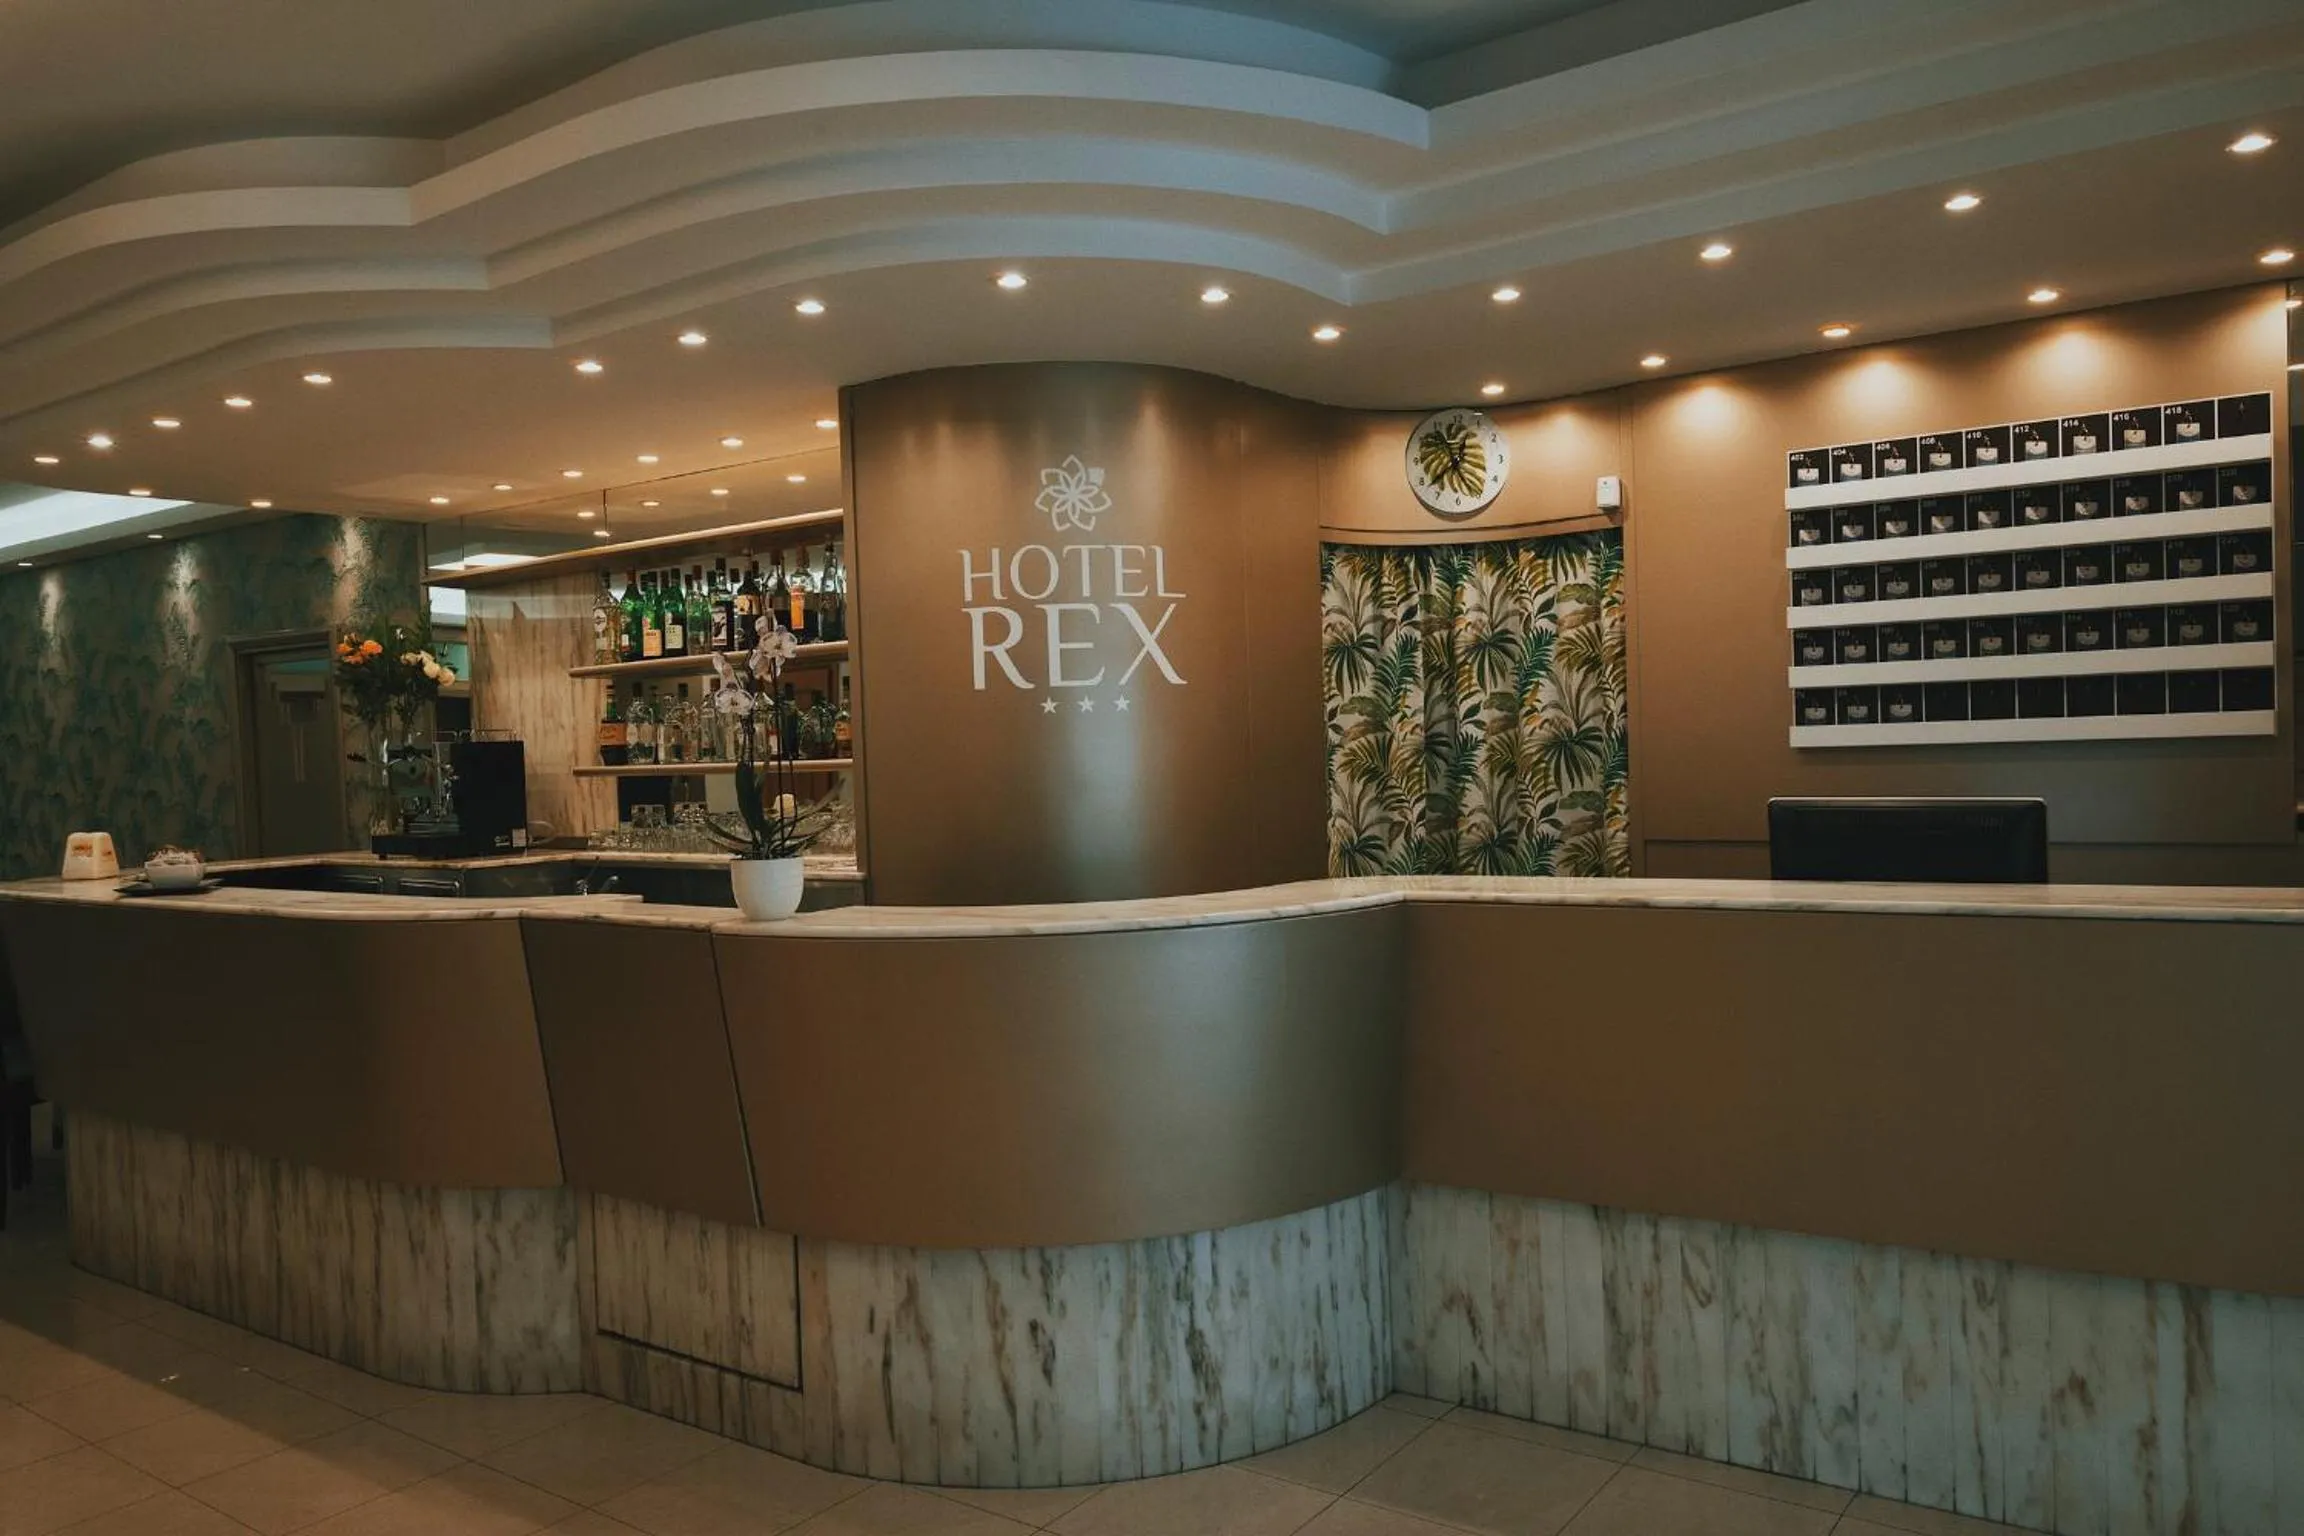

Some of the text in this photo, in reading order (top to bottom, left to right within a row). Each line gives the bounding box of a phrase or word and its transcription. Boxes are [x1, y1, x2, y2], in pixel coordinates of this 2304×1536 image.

[2165, 406, 2182, 415] 418
[2113, 413, 2130, 421] 416
[2063, 419, 2079, 427] 414
[2015, 425, 2030, 433] 412
[1490, 432, 1497, 443] 2
[1967, 431, 1982, 439] 410
[958, 544, 1187, 602] HOTEL
[961, 603, 1188, 690] REX
